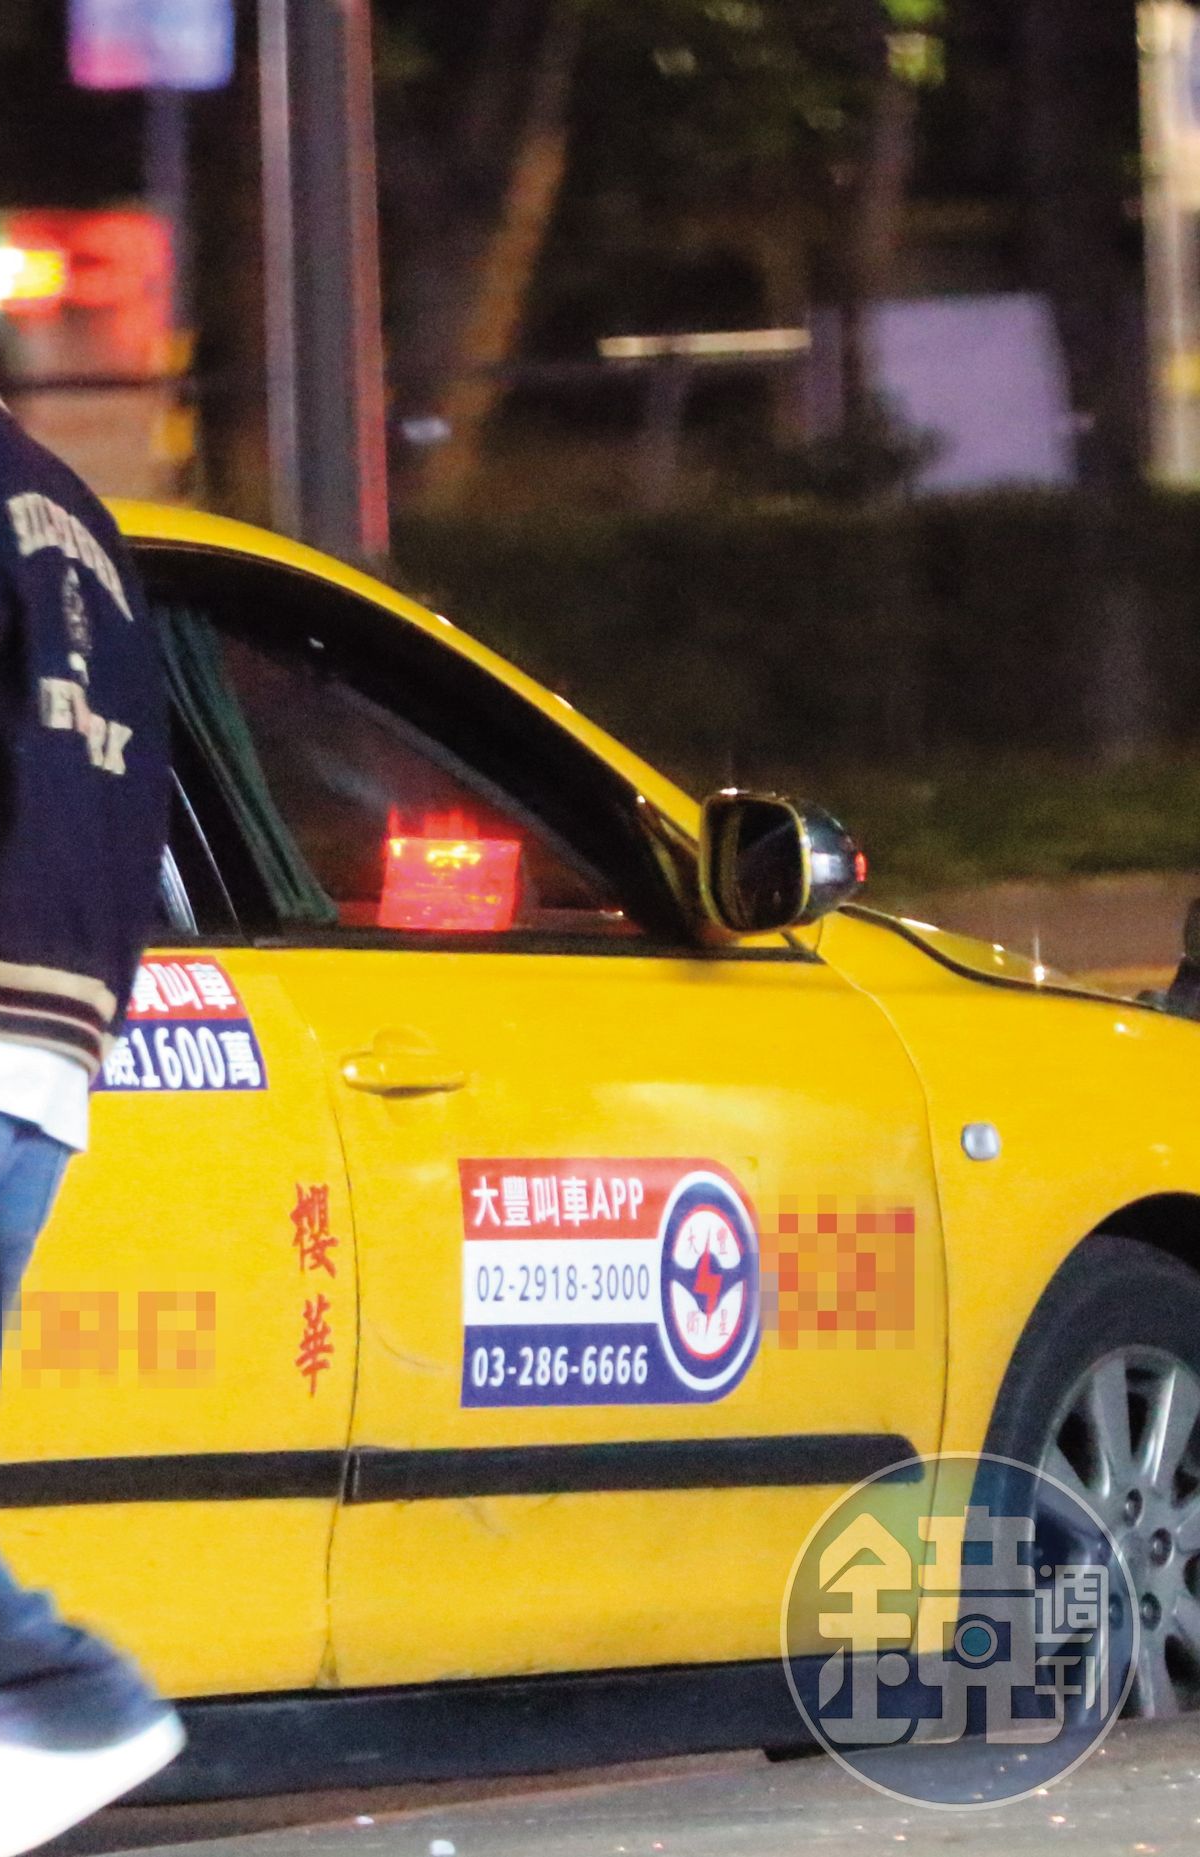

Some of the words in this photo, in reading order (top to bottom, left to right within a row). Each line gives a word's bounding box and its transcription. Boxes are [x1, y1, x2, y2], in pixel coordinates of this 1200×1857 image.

[471, 1175, 644, 1227] 大豐叫車APP
[477, 1263, 651, 1303] 02-2918-3000
[471, 1345, 648, 1388] 03-286-6666
